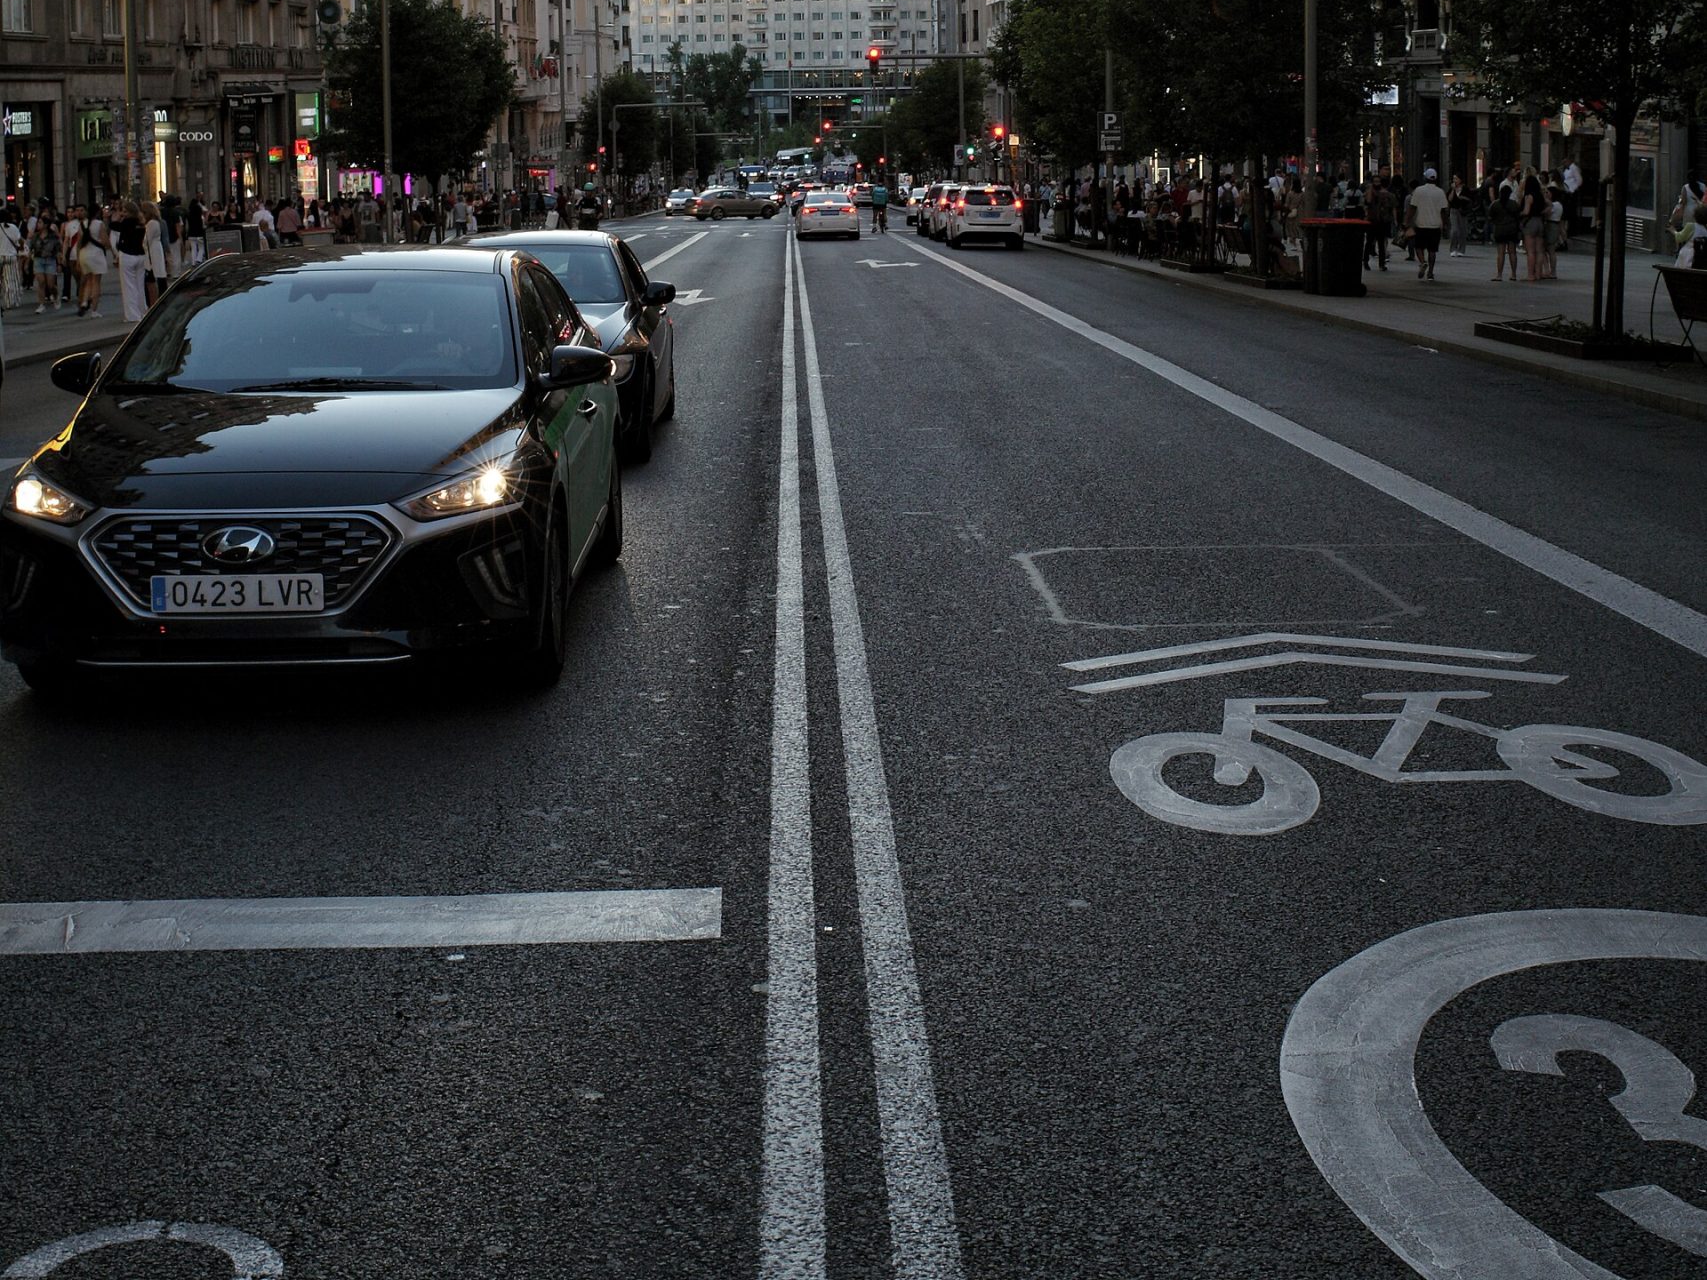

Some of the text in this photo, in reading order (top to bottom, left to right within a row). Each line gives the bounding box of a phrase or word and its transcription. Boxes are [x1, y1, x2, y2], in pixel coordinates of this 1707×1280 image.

[1104, 113, 1117, 130] P
[179, 131, 213, 142] CODO
[172, 579, 313, 607] 0423 LVR
